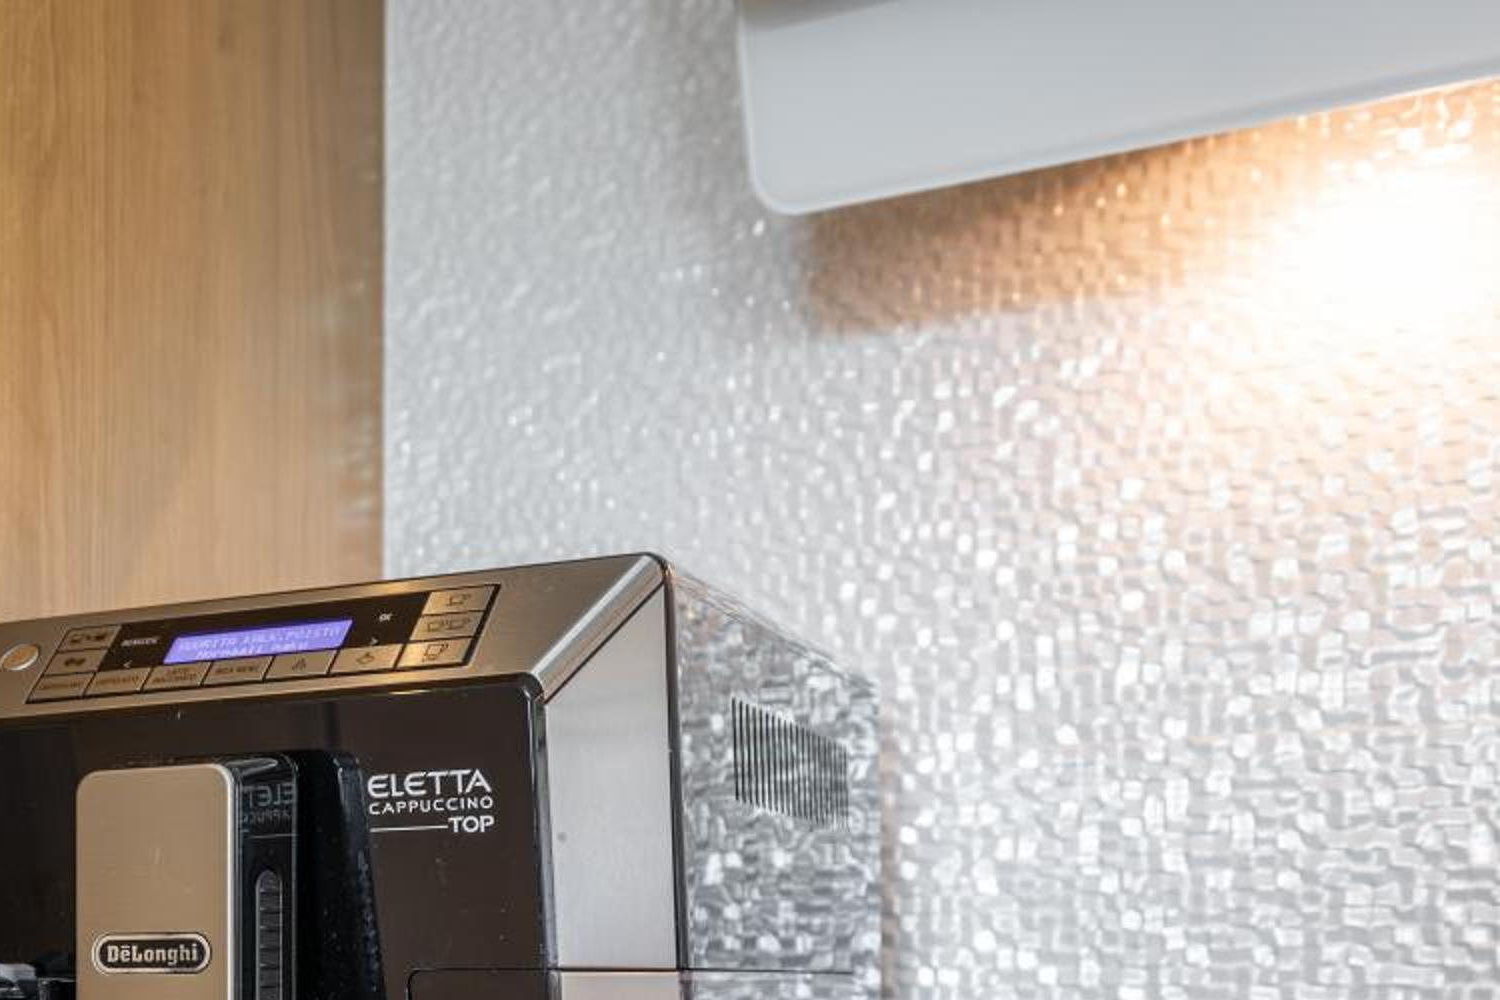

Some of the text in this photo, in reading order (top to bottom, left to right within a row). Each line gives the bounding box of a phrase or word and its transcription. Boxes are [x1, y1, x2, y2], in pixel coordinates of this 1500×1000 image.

[367, 768, 492, 798] ELETTA
[369, 795, 493, 815] CAPPUCCINO
[448, 815, 495, 833] TOP
